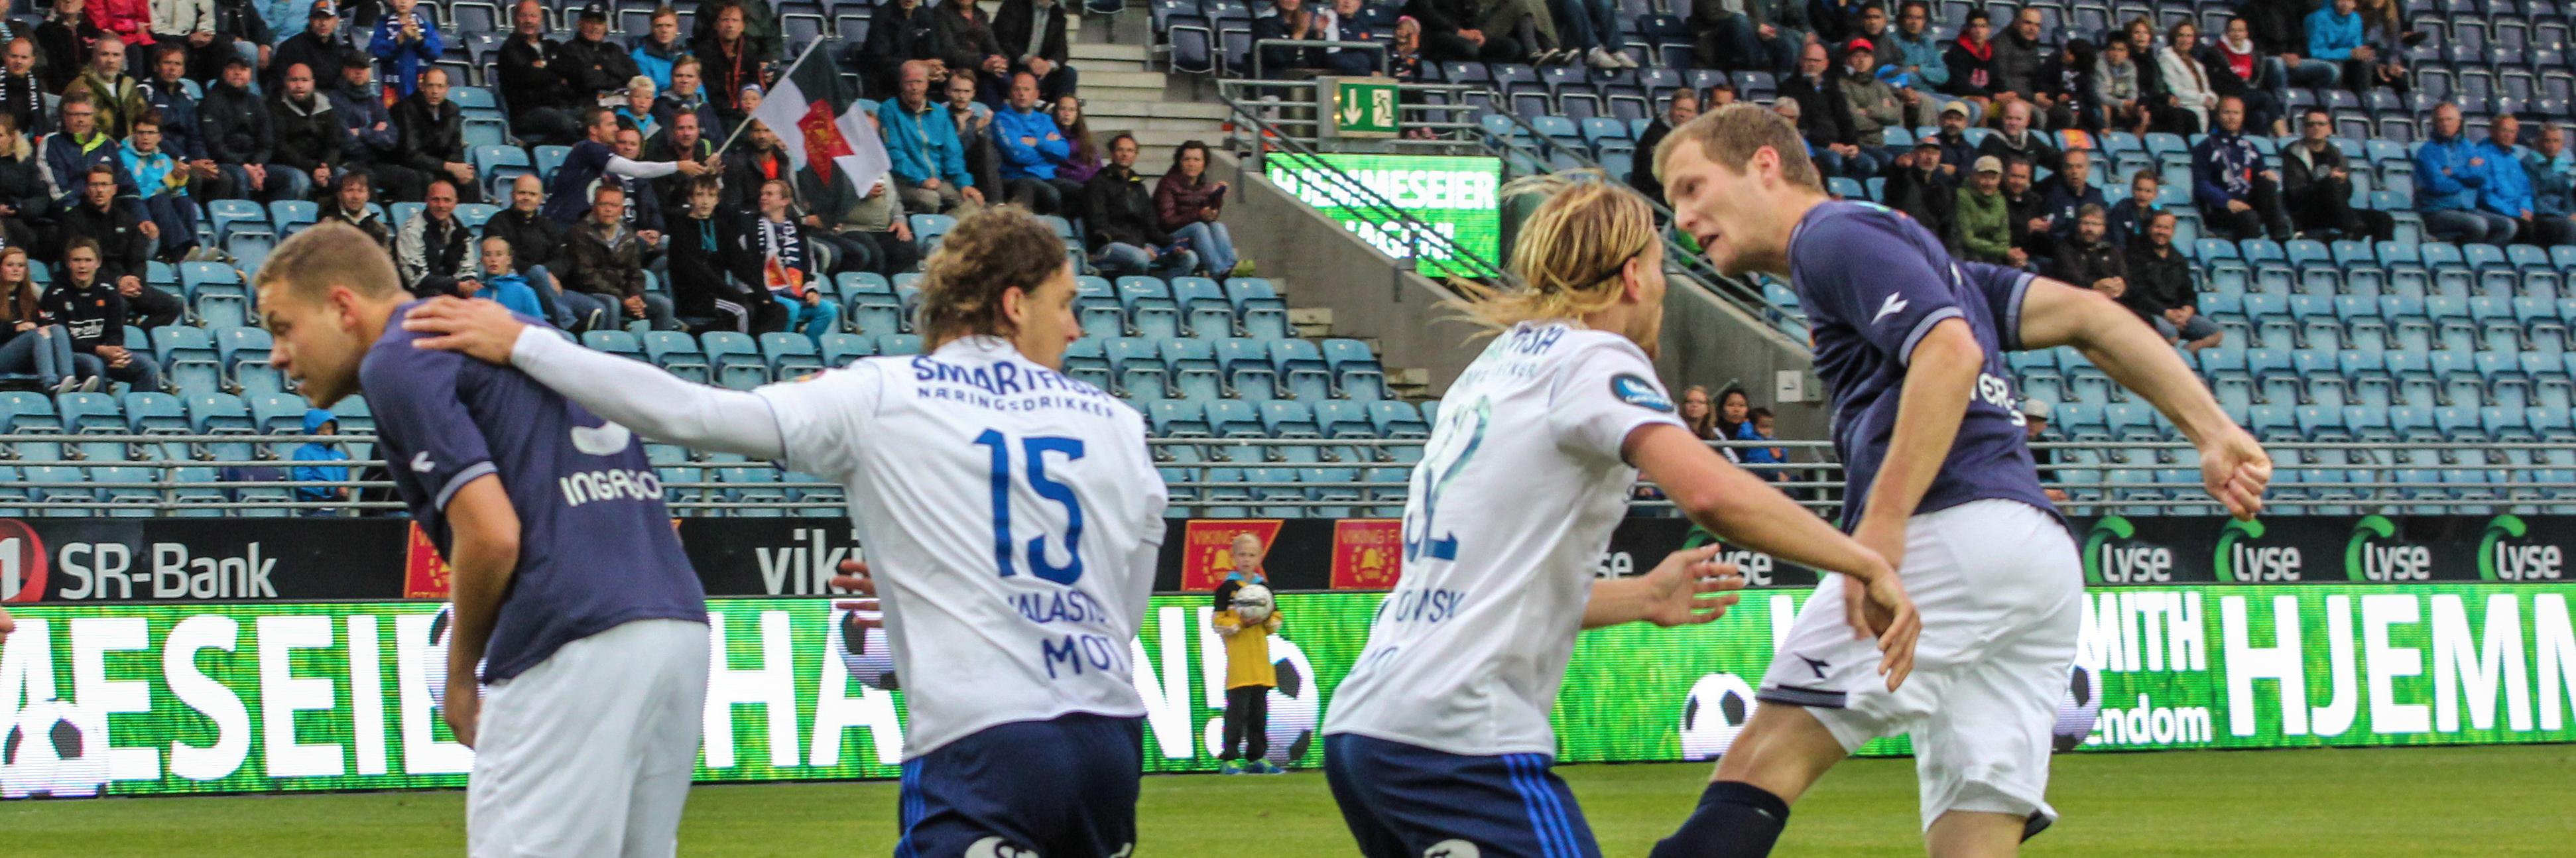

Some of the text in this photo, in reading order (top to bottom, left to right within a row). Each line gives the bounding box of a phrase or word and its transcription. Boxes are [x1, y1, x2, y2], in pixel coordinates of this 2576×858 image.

[973, 428, 1085, 585] 15
[58, 542, 278, 599] SR-Bank
[2102, 542, 2172, 582] Lyse
[2233, 542, 2301, 582] Lyse
[2364, 542, 2431, 581] Lyse
[2496, 540, 2562, 581] Lyse
